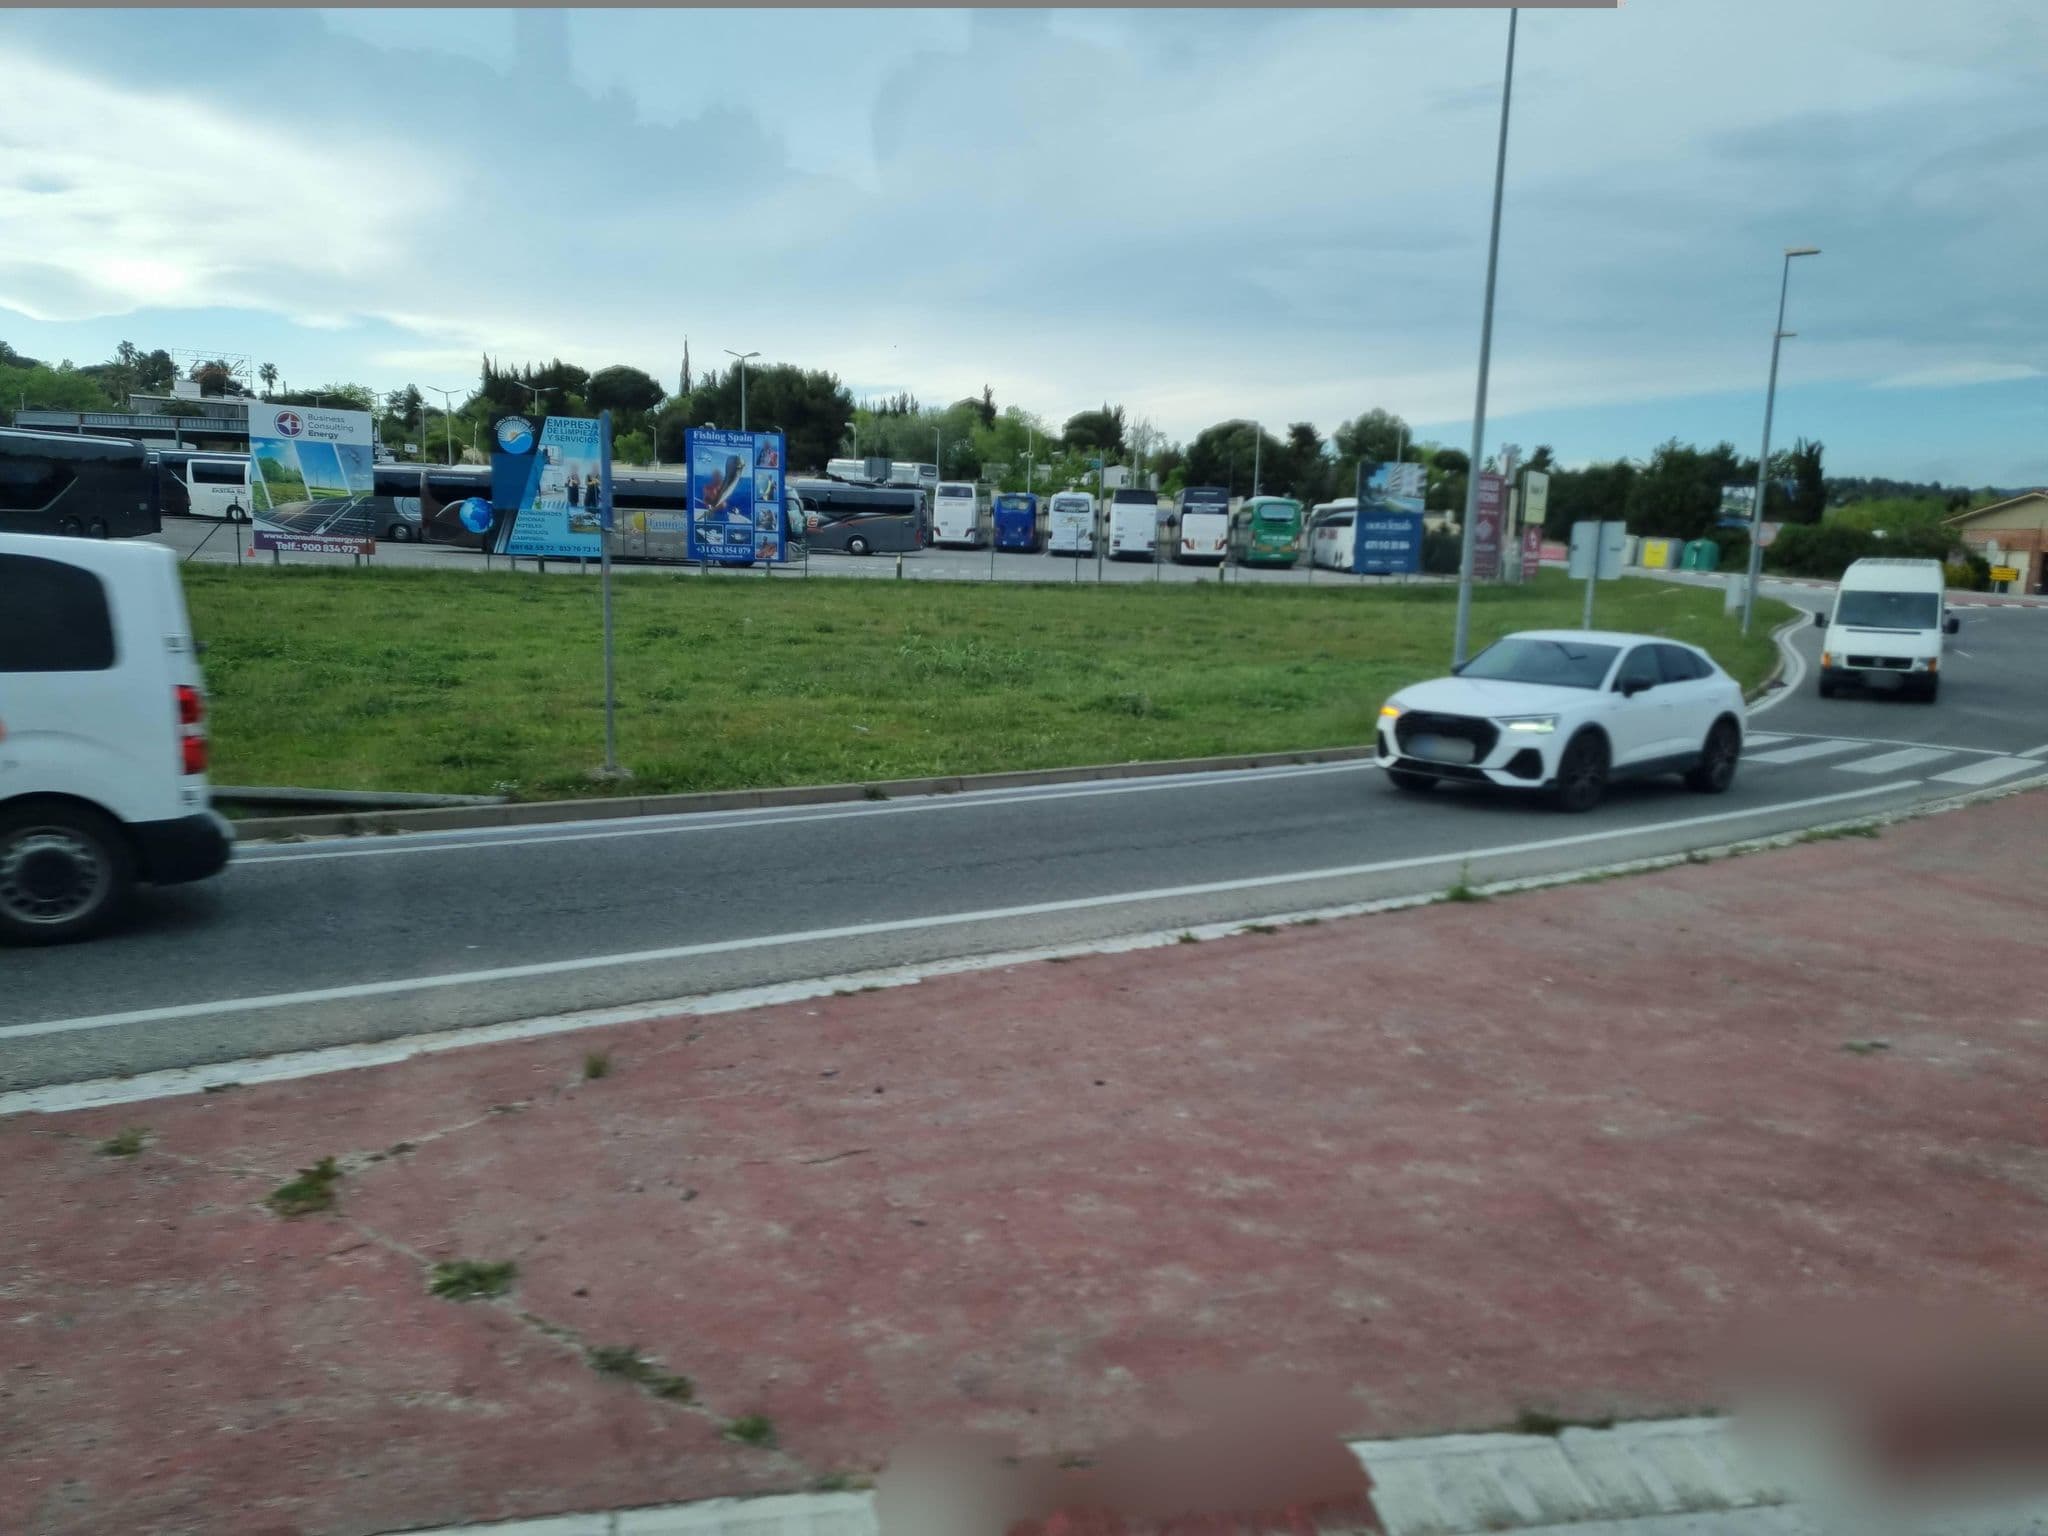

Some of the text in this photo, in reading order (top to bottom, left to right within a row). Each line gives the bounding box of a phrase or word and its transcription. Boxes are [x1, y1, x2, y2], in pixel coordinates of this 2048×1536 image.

[308, 414, 345, 423] Business
[547, 418, 598, 430] EMPRESA
[308, 421, 354, 432] Consulting
[308, 430, 338, 439] Energy
[560, 428, 599, 437] LIMPIEZA
[693, 430, 752, 443] Fishing Spain
[554, 434, 599, 443] SERVICIOS
[263, 532, 372, 545] www.bconsultingenergy.com
[276, 541, 359, 554] Telf.: 900 834 972
